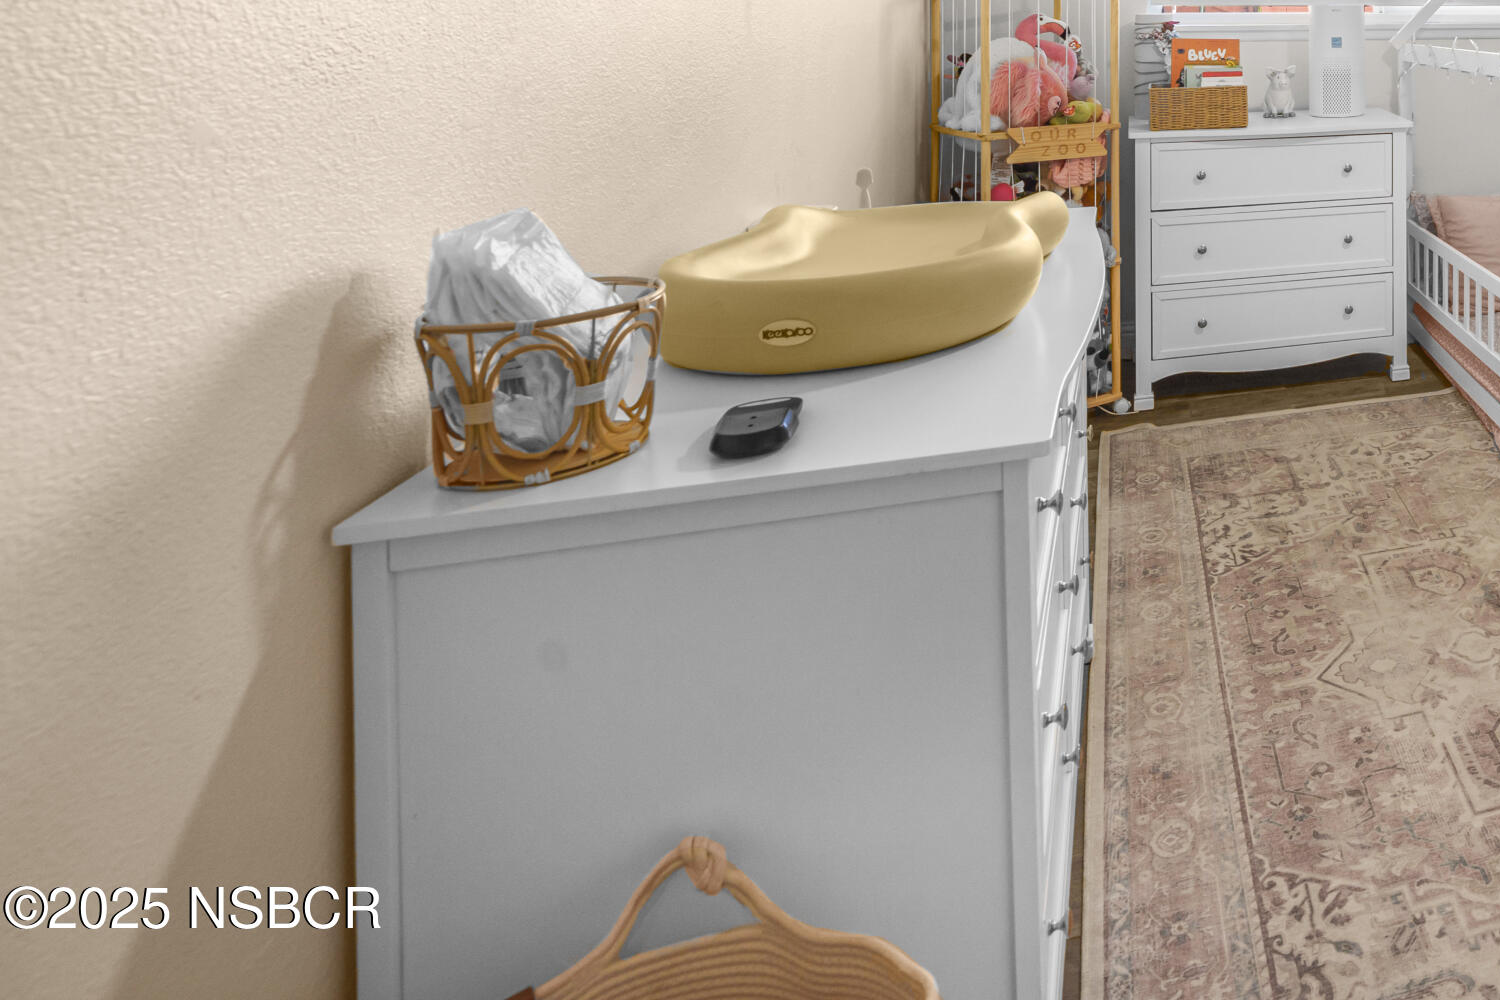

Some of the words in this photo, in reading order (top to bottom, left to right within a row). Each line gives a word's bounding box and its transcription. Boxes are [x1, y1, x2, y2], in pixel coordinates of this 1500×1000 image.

[1187, 48, 1227, 61] BLUEY
[1031, 128, 1076, 140] OUR
[1041, 143, 1086, 157] ZOO
